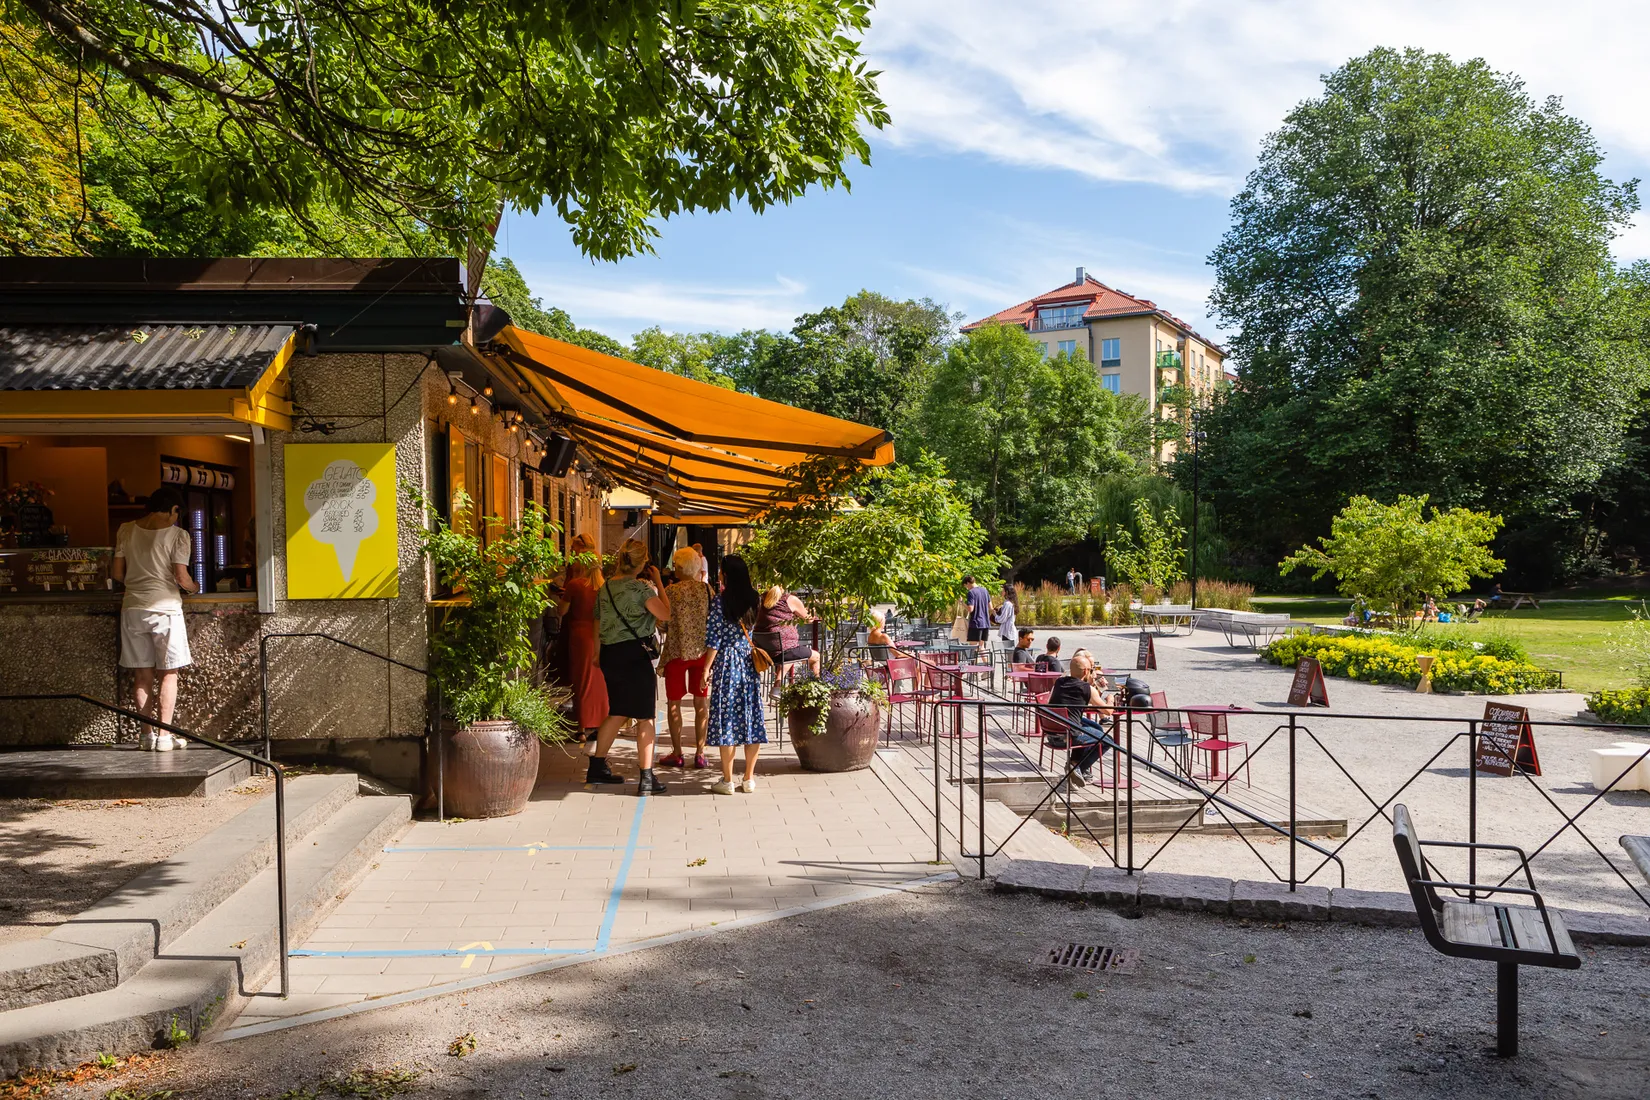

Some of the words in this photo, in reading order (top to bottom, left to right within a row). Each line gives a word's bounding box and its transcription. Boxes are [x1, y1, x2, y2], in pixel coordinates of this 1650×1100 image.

[324, 466, 368, 481] GELATO
[310, 482, 330, 490] LITEN
[321, 500, 354, 511] DRYCK
[48, 548, 82, 561] GLASSAR
